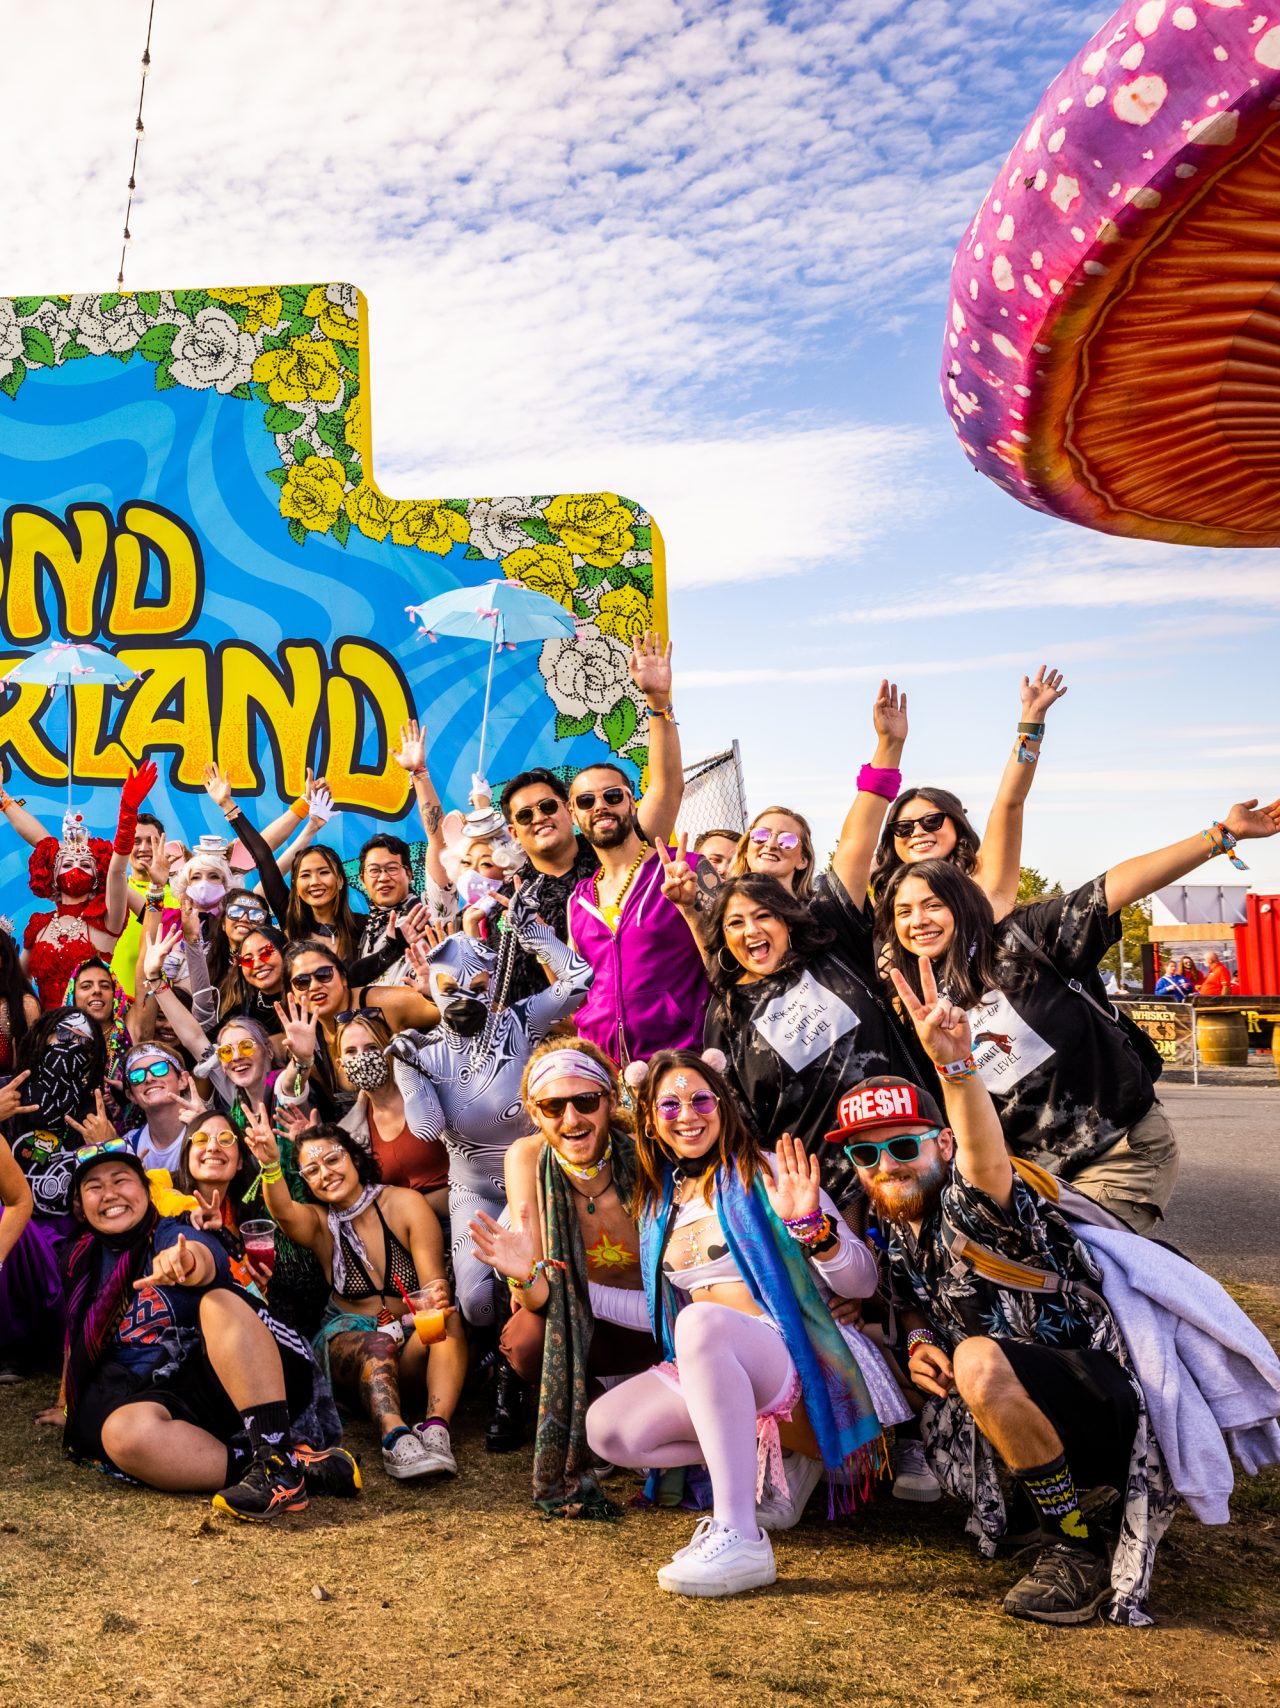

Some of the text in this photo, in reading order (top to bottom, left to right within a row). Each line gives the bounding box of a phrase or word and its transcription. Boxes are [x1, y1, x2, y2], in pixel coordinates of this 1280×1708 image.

[784, 1004, 828, 1042] SPIRITUAL
[1131, 1010, 1177, 1021] WHISKEY
[801, 1020, 832, 1046] LEVEL
[976, 1034, 1017, 1070] SPIRITL
[993, 1053, 1022, 1076] LEVEL
[840, 1088, 913, 1127] FRE$H
